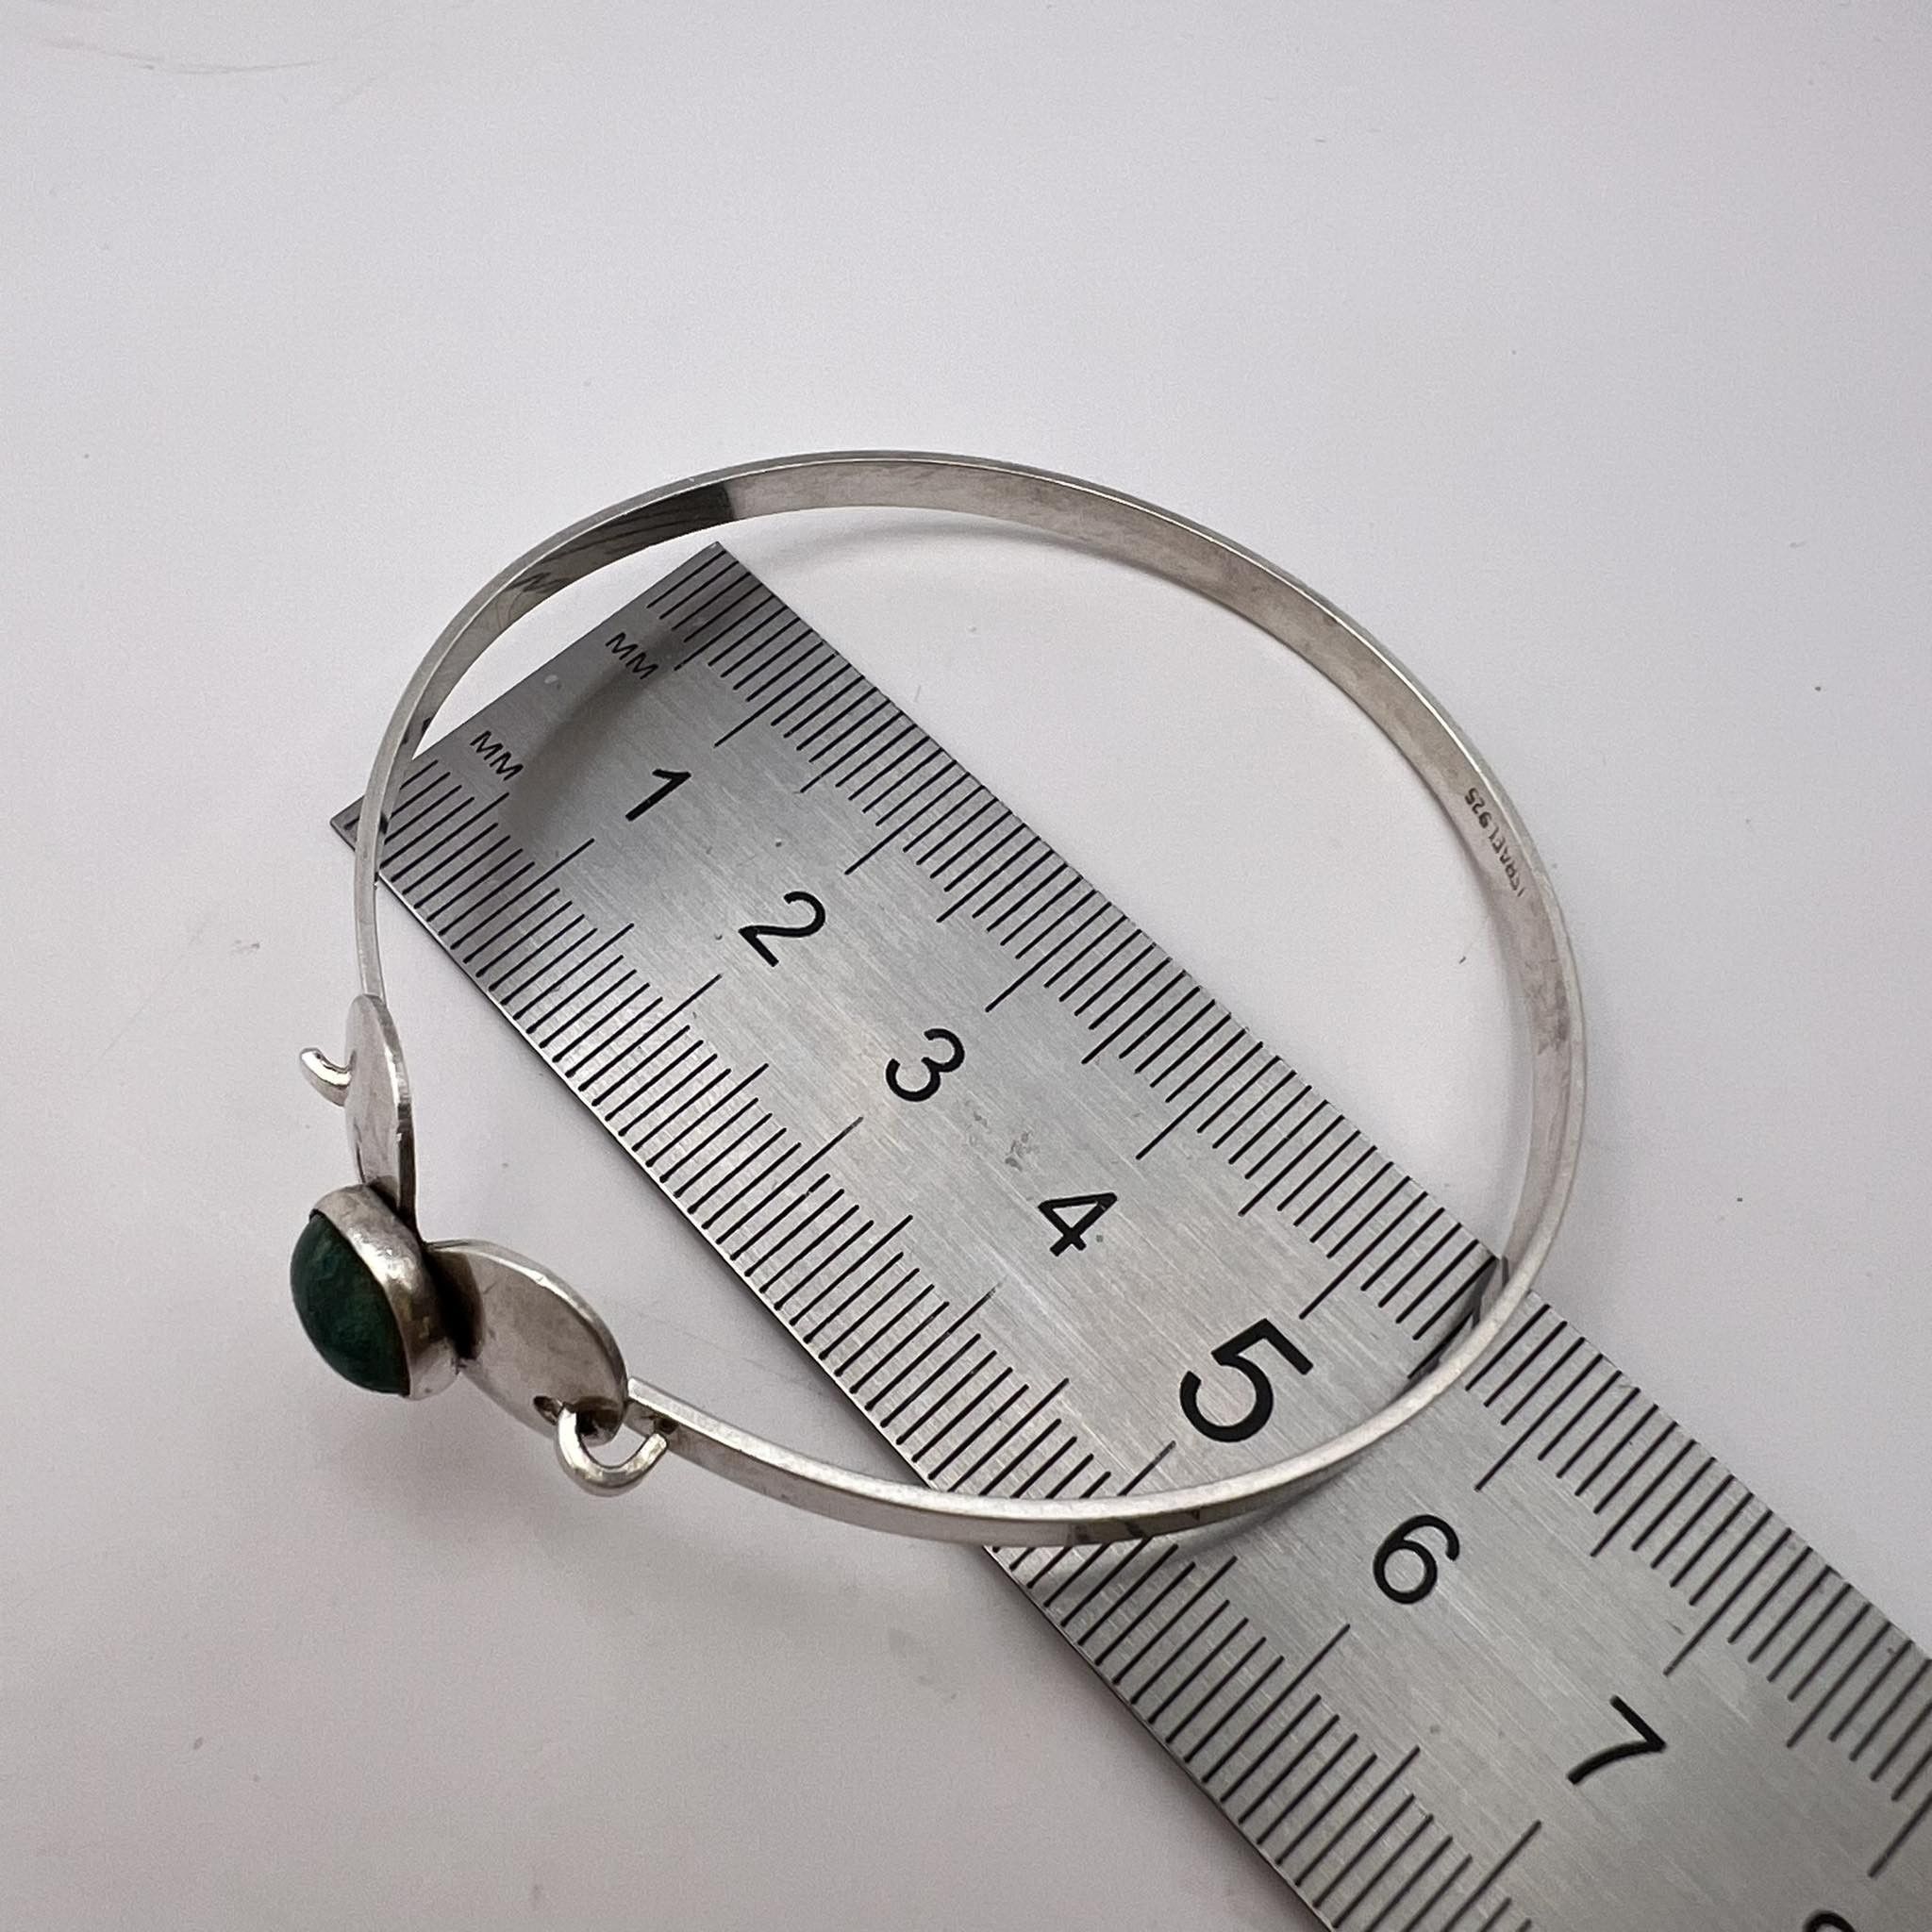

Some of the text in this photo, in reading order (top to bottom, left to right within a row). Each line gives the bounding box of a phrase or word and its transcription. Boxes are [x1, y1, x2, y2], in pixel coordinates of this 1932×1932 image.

[605, 631, 659, 680] MM
[470, 729, 525, 781] MM
[625, 768, 692, 823] 1
[1464, 787, 1492, 829] 925
[737, 891, 826, 968] 2
[885, 1027, 966, 1103] 3
[1037, 1191, 1119, 1257] 4
[1178, 1318, 1314, 1443] 5
[1373, 1513, 1461, 1606] 6
[1566, 1694, 1668, 1787] 7
